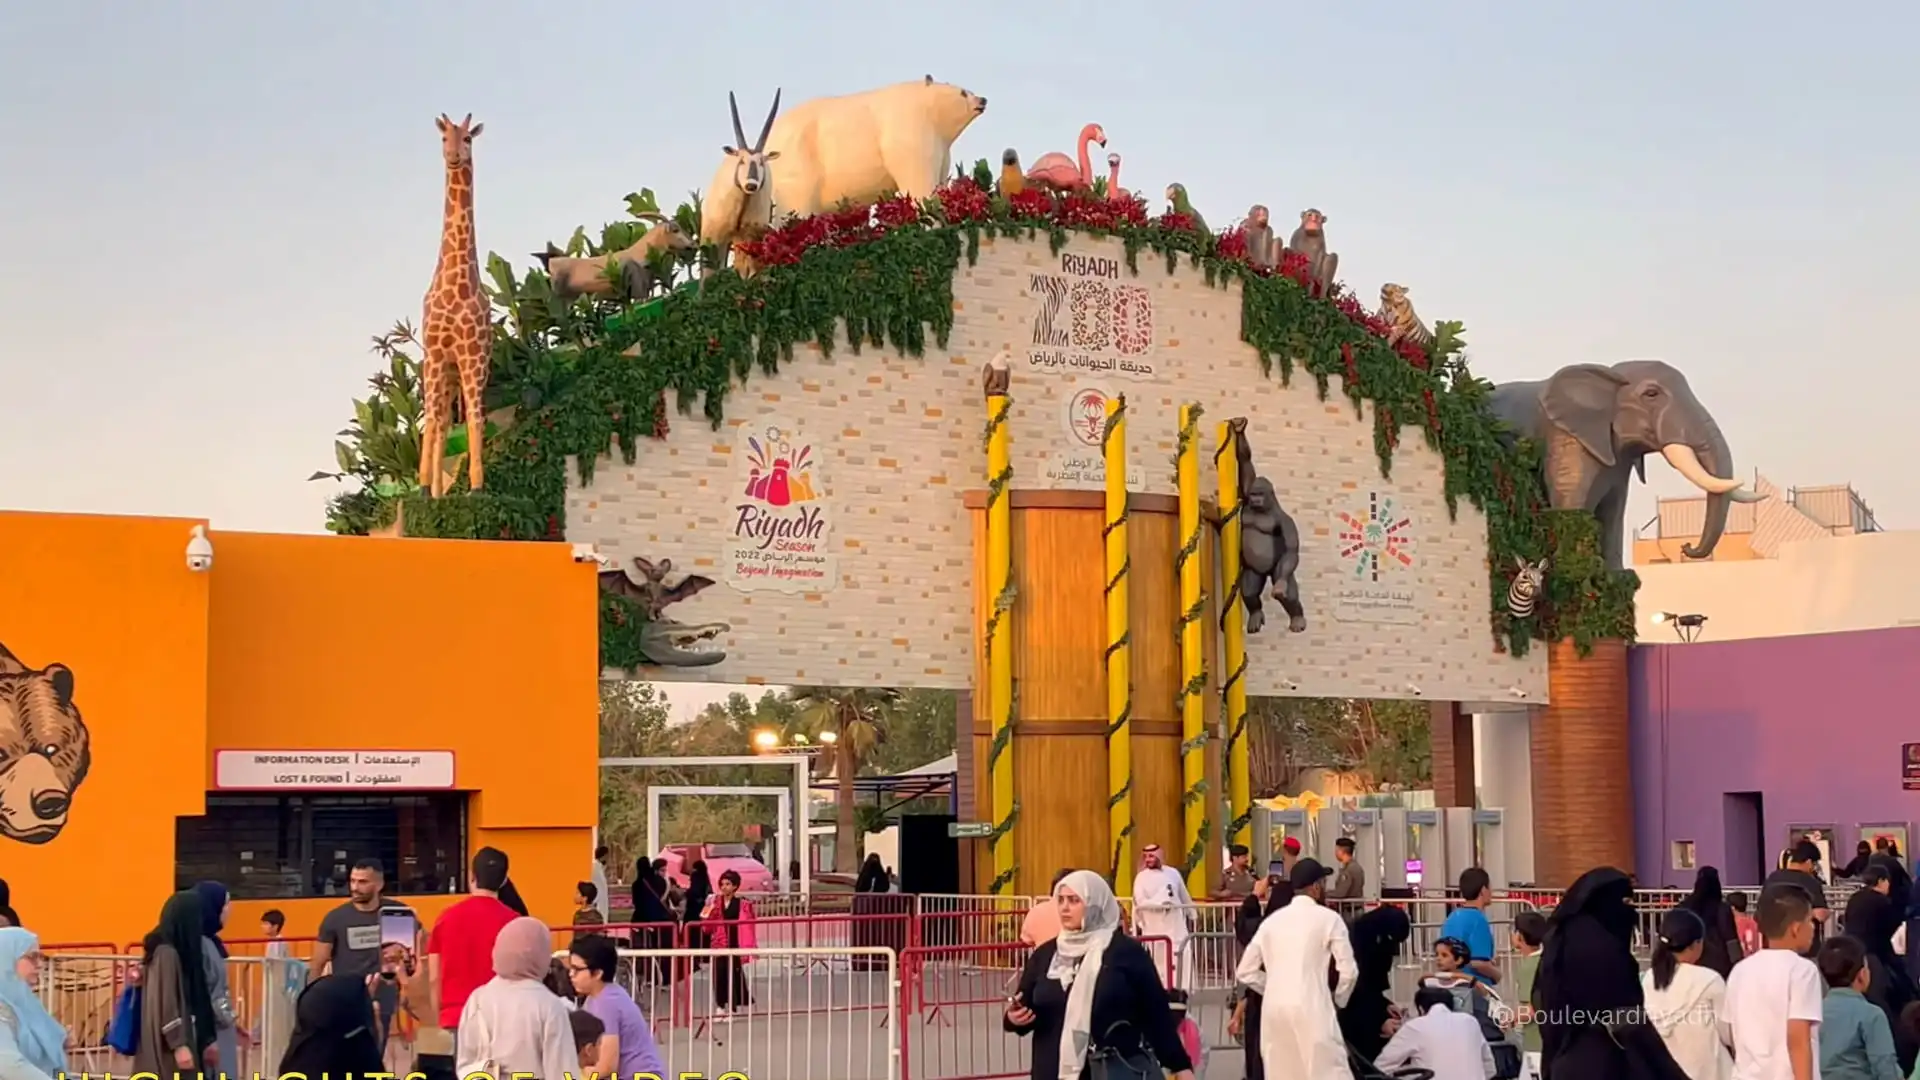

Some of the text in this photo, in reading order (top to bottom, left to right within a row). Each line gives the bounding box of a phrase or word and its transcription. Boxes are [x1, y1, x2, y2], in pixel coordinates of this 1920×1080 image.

[1030, 274, 1152, 356] ZOO
[1027, 350, 1152, 376] حديقة الحيوانات بالرياض
[735, 504, 825, 549] Riyadh
[774, 538, 816, 552] Season
[735, 549, 760, 560] 2022
[735, 562, 825, 580] Beyond Imagination
[254, 755, 349, 765] INFORMATION DESK
[274, 774, 343, 784] LOST & FOUND
